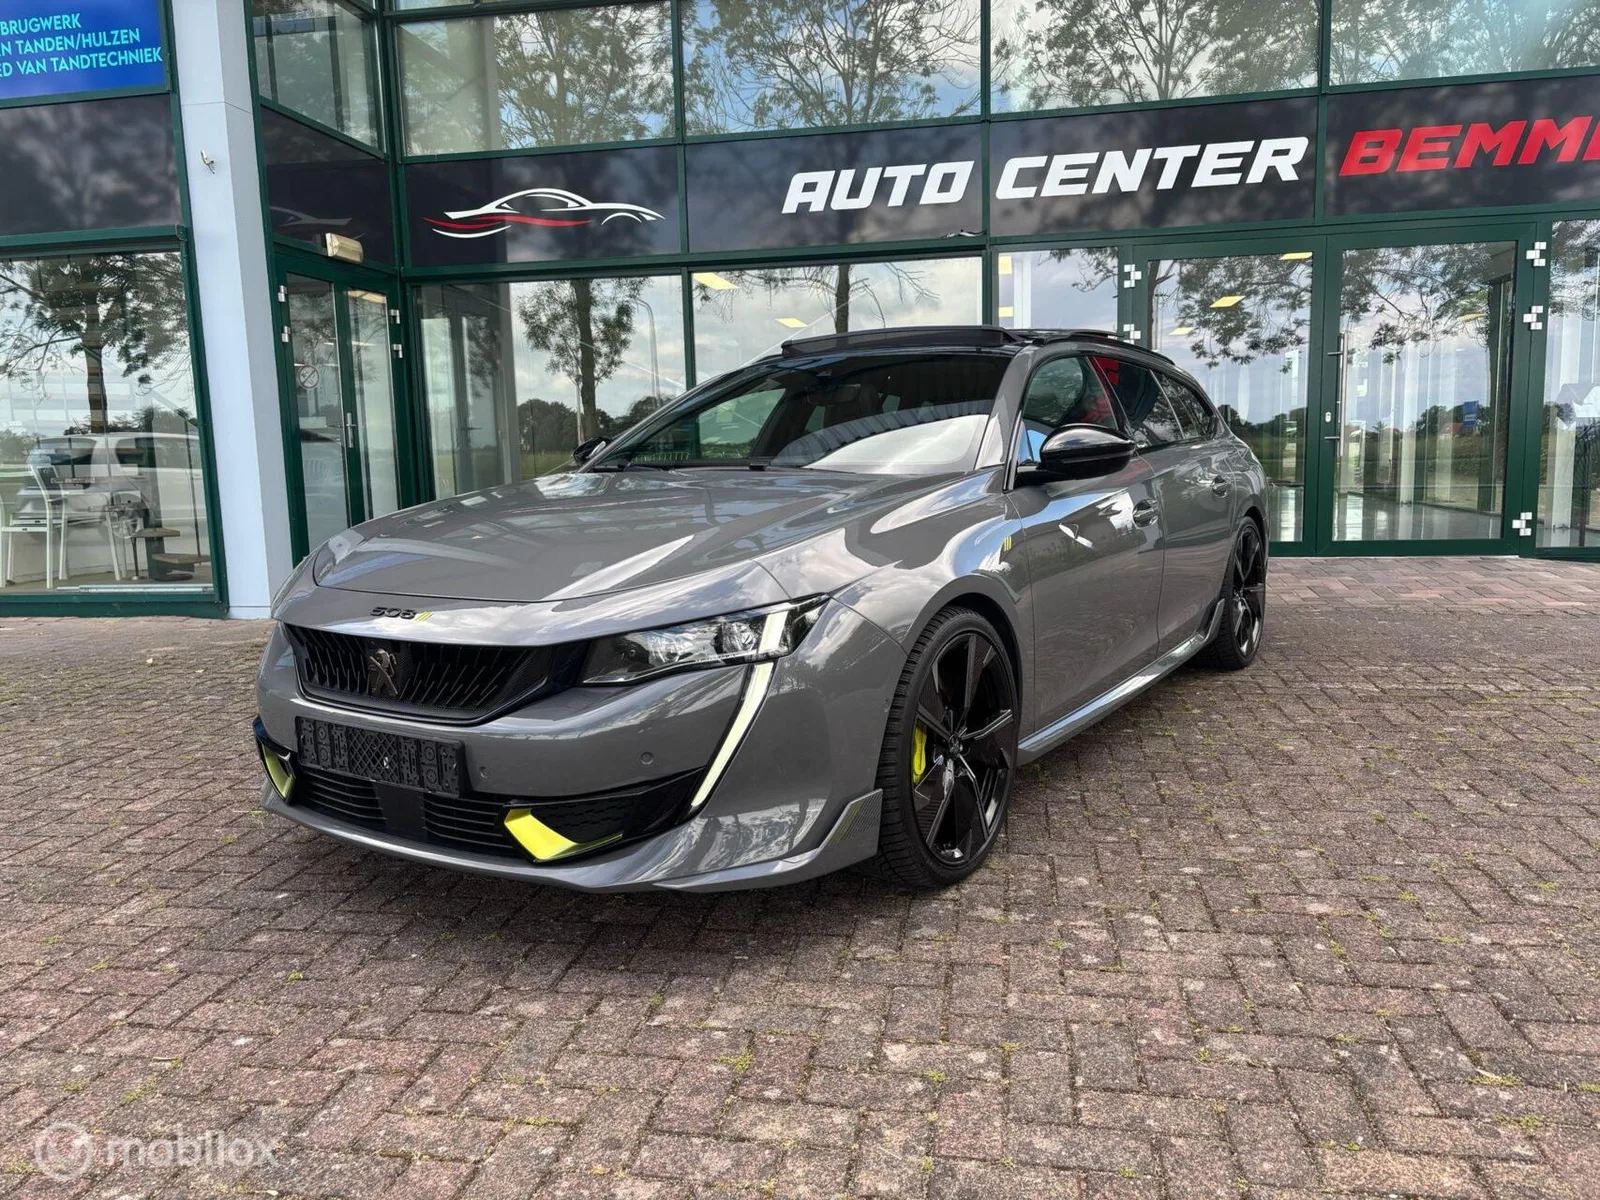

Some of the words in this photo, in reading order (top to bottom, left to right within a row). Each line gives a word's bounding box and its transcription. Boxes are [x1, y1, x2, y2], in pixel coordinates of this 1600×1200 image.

[15, 28, 141, 55] TANDEN/HULZEN
[16, 58, 47, 75] VAN
[50, 46, 164, 73] TANDTECHNIEK
[781, 160, 975, 214] AUTO
[995, 136, 1310, 200] CENTER
[1338, 115, 1600, 176] BEMM
[370, 607, 418, 620] 508
